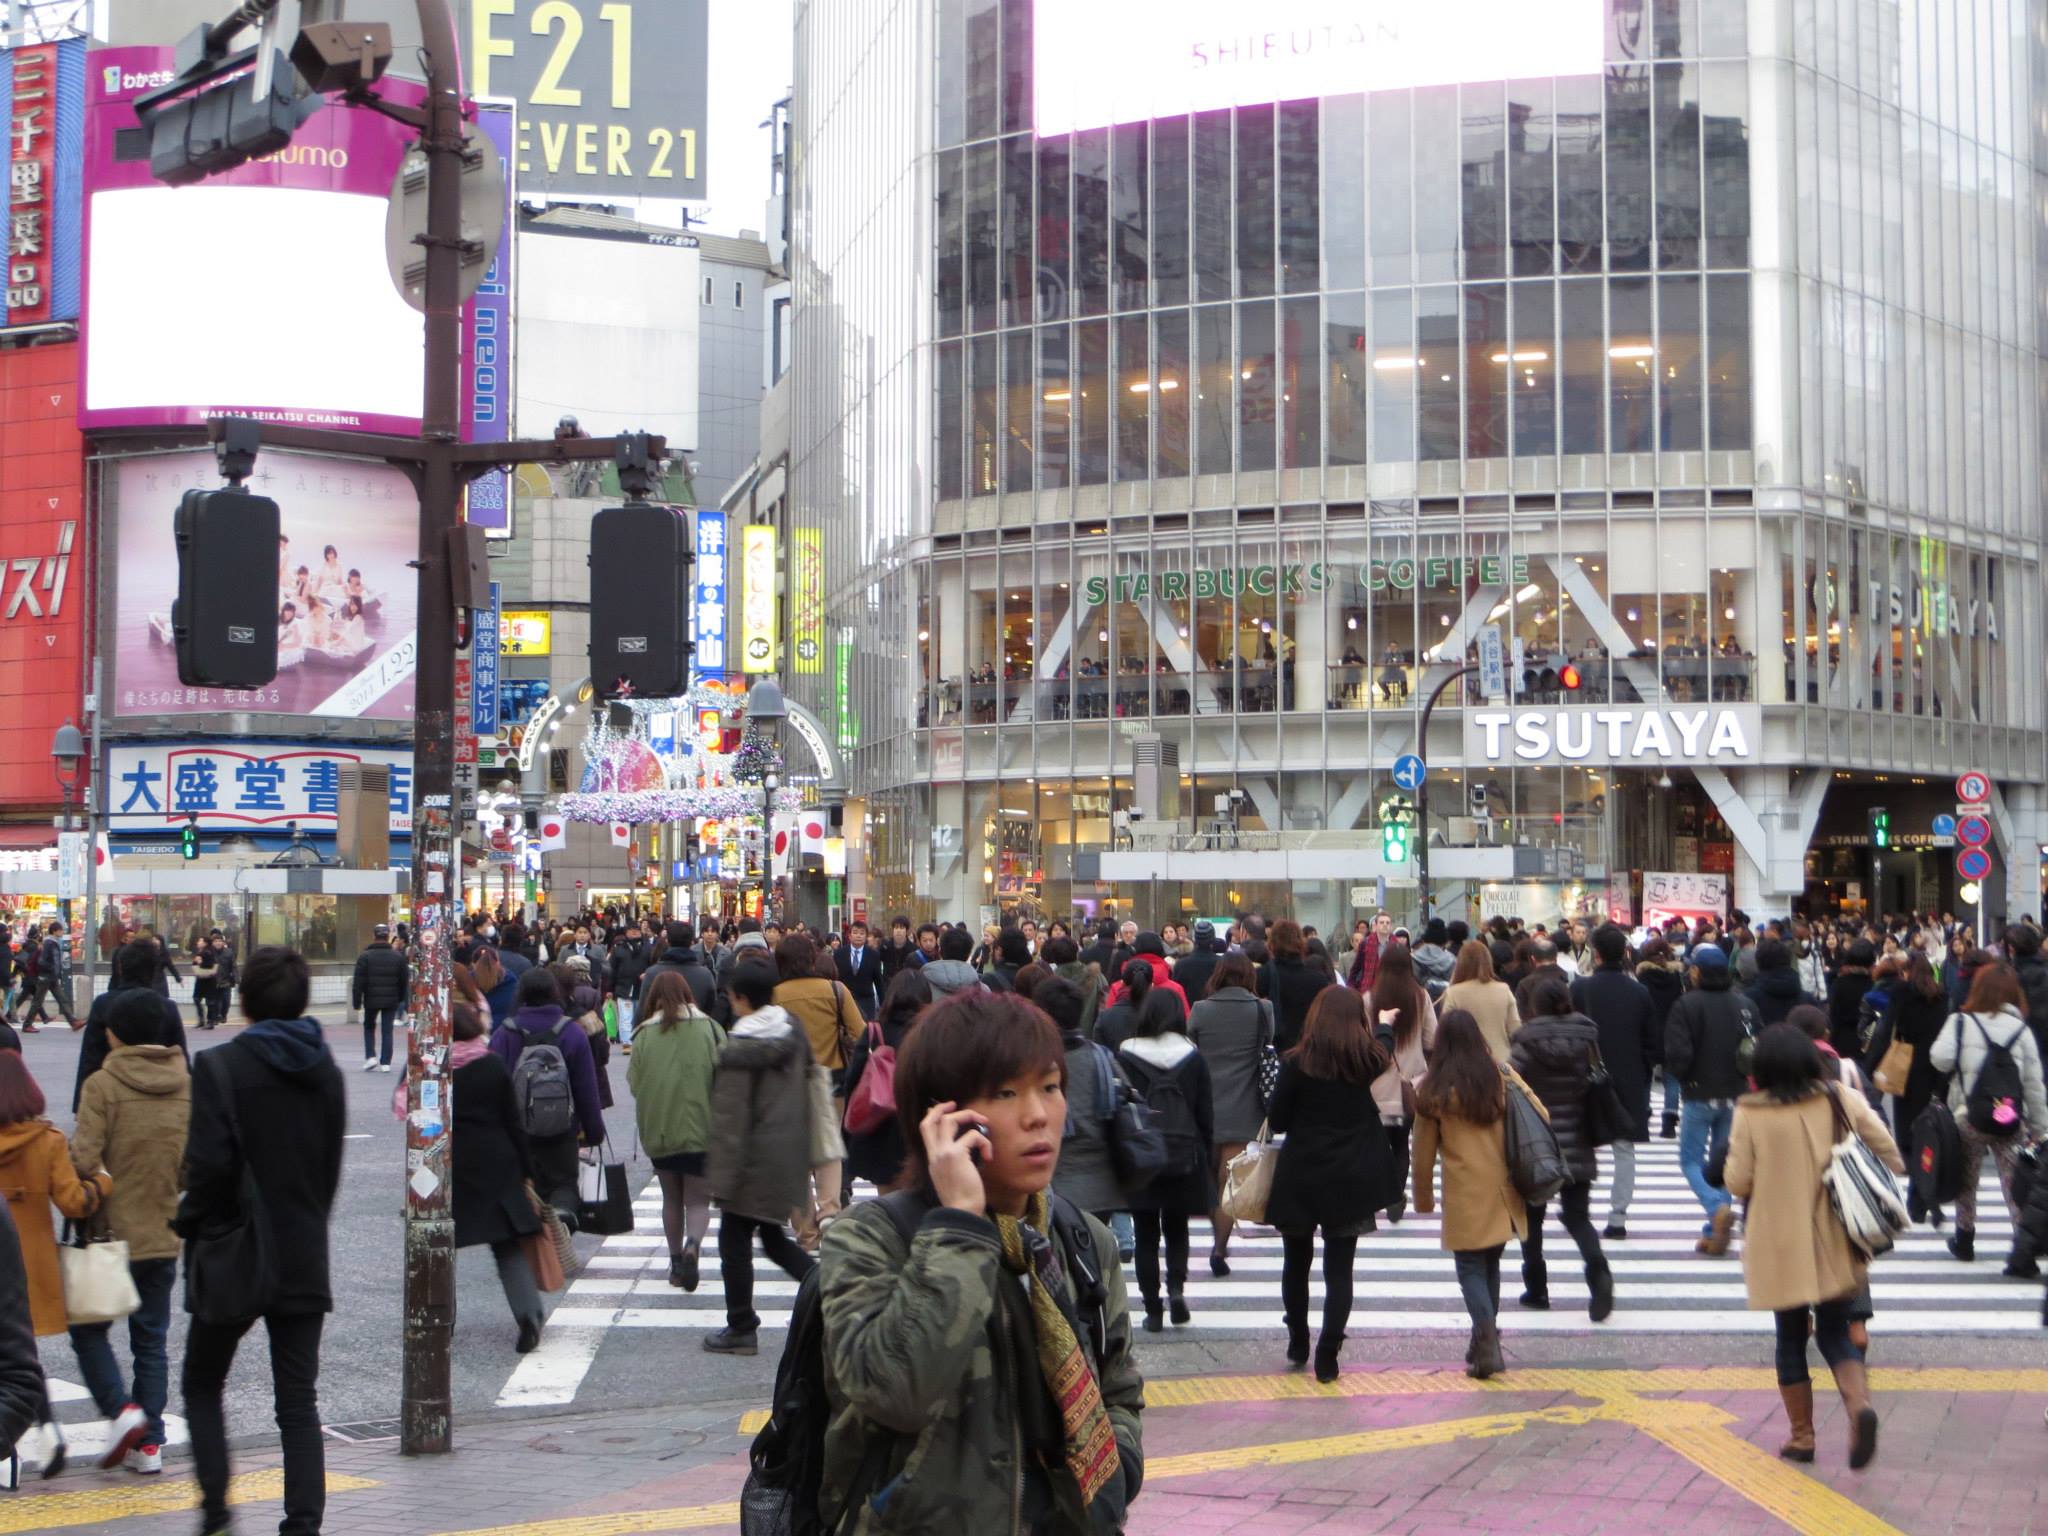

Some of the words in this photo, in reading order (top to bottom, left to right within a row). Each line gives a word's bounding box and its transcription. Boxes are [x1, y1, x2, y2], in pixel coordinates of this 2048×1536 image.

[648, 128, 696, 179] 21
[7, 53, 47, 308] 三千里薬品
[473, 309, 497, 422] neon
[252, 411, 303, 422] SEIKATSU
[307, 413, 361, 426] CHANNEL
[1086, 562, 1334, 605] STARBUCKS
[1360, 554, 1530, 590] COFFEE
[476, 596, 495, 724] 盛堂商事ビル
[749, 642, 769, 658] 4F
[1475, 710, 1749, 759] TSUTAYA
[132, 846, 176, 855] TAISEIDO
